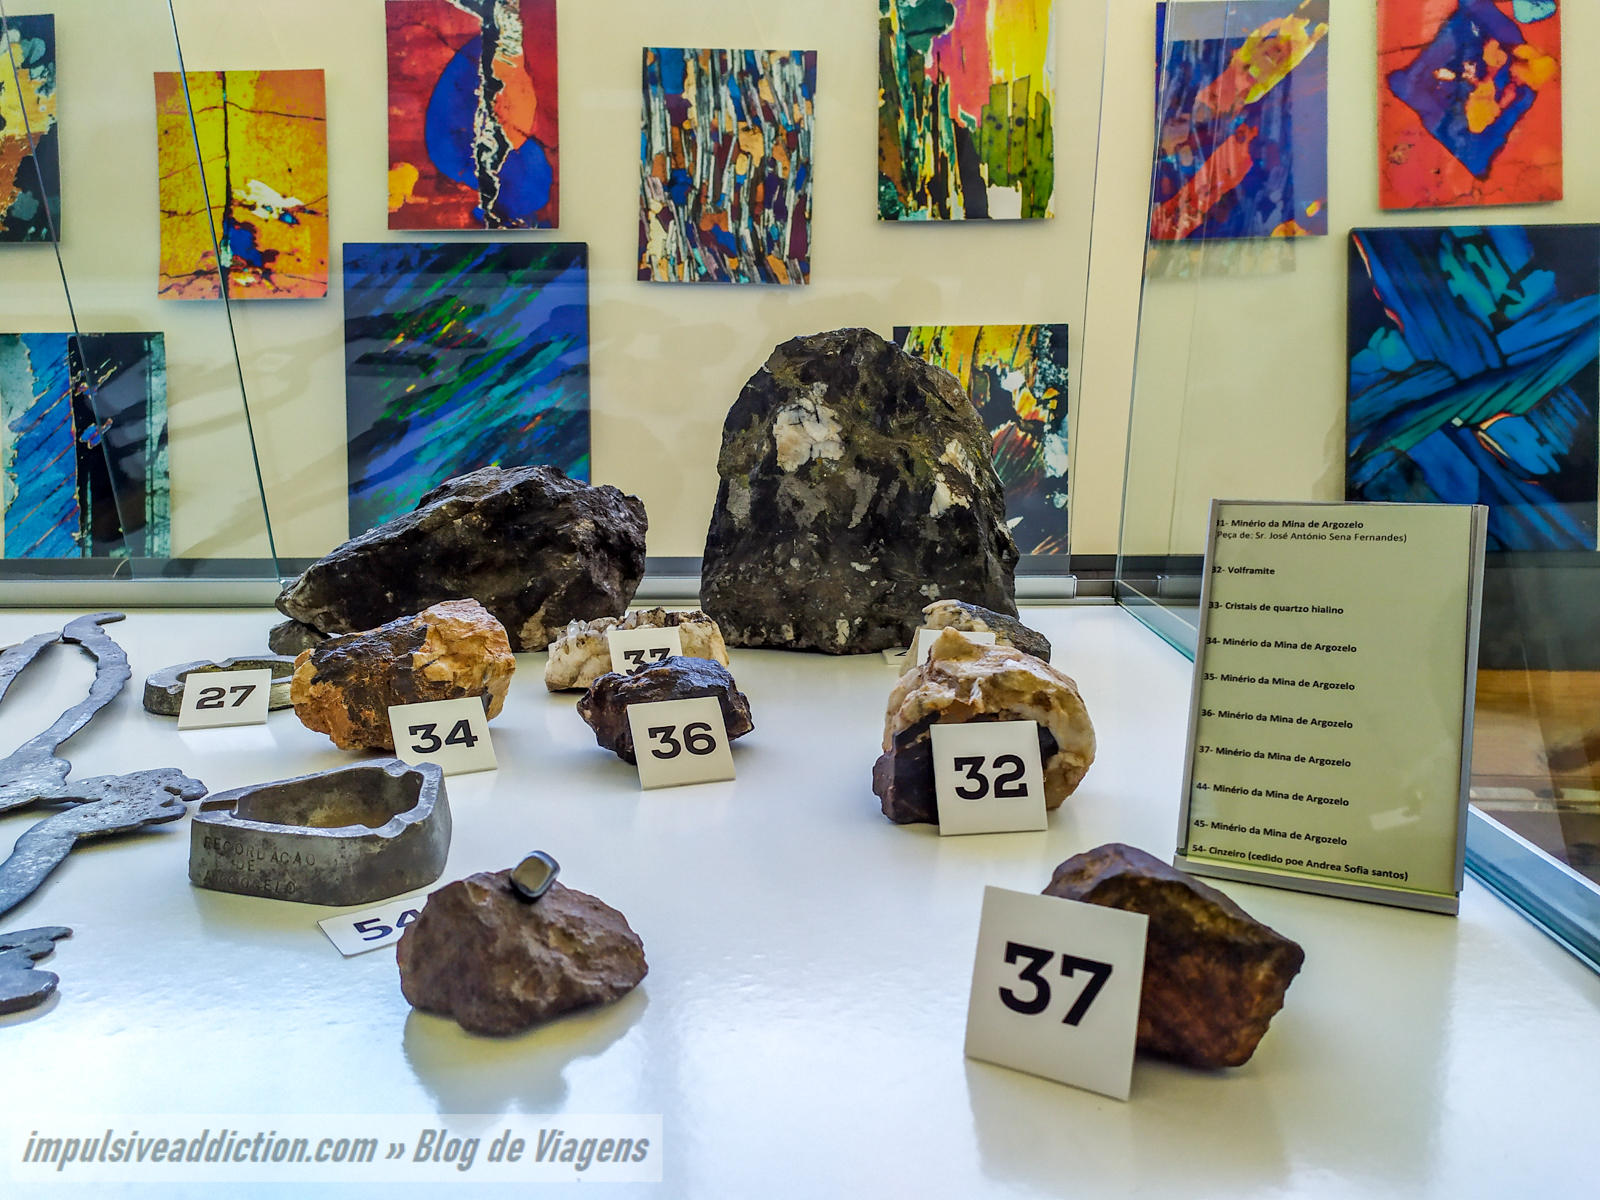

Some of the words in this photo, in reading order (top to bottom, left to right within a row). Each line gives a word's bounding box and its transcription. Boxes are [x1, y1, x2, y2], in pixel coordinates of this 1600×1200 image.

[1231, 519, 1264, 529] Minério
[1268, 519, 1280, 529] da
[1281, 520, 1306, 529] Mina
[1307, 520, 1320, 529] de
[1321, 521, 1364, 532] Argozelo
[1239, 531, 1253, 540] de:
[1255, 532, 1266, 540] Sr.
[1269, 531, 1288, 541] José
[1290, 532, 1327, 541] António
[1329, 533, 1352, 541] Sena
[1354, 533, 1407, 543] Fernandes)
[1227, 566, 1275, 575] Volframite
[1208, 601, 1223, 609] 33-
[1225, 602, 1258, 611] Cristais
[1259, 603, 1271, 611] de
[1273, 604, 1309, 614] quartzo
[1311, 604, 1344, 615] hialino
[1206, 637, 1220, 645] 34-
[1222, 637, 1259, 648] Minério
[1260, 639, 1272, 648] da
[1274, 639, 1298, 650] Mina
[1300, 641, 1313, 651] de
[1314, 642, 1357, 654] Argozelo
[1204, 672, 1218, 682] 35-
[1220, 673, 1256, 684] Minério
[1257, 675, 1270, 685] da
[1272, 677, 1296, 687] Mina
[1298, 678, 1311, 688] de
[1312, 679, 1355, 691] Argozelo
[196, 685, 256, 709] 27
[1201, 709, 1215, 718] 36-
[1218, 710, 1254, 721] Minério
[1255, 713, 1268, 722] da
[1269, 714, 1294, 724] Mina
[1296, 716, 1309, 725] de
[1310, 718, 1353, 729] Argozelo
[408, 719, 478, 753] 34
[648, 722, 716, 759] 36
[1199, 745, 1213, 754] 37-
[1215, 747, 1252, 758] Minério
[1253, 750, 1265, 759] da
[1267, 752, 1292, 761] Mina
[1293, 754, 1306, 764] de
[1308, 755, 1351, 768] Argozelo
[953, 755, 1028, 800] 32
[1197, 783, 1211, 792] 44-
[1213, 784, 1249, 795] Minério
[1251, 787, 1263, 797] da
[1265, 789, 1290, 800] Mina
[1291, 792, 1304, 801] de
[1306, 793, 1349, 806] Argozelo
[1194, 819, 1208, 828] 45-
[1210, 821, 1247, 833] Minério
[1249, 825, 1261, 835] da
[1263, 827, 1287, 838] Mina
[1289, 830, 1302, 840] de
[1304, 832, 1347, 846] Argozelo
[1192, 844, 1206, 854] 54-
[1208, 846, 1246, 859] Cinzeiro
[1246, 851, 1283, 865] (cedido
[1284, 856, 1304, 867] poe
[1304, 859, 1342, 872] Andrea
[1343, 864, 1369, 875] Sofia
[1370, 868, 1408, 882] santos)
[999, 941, 1113, 1027] 37
